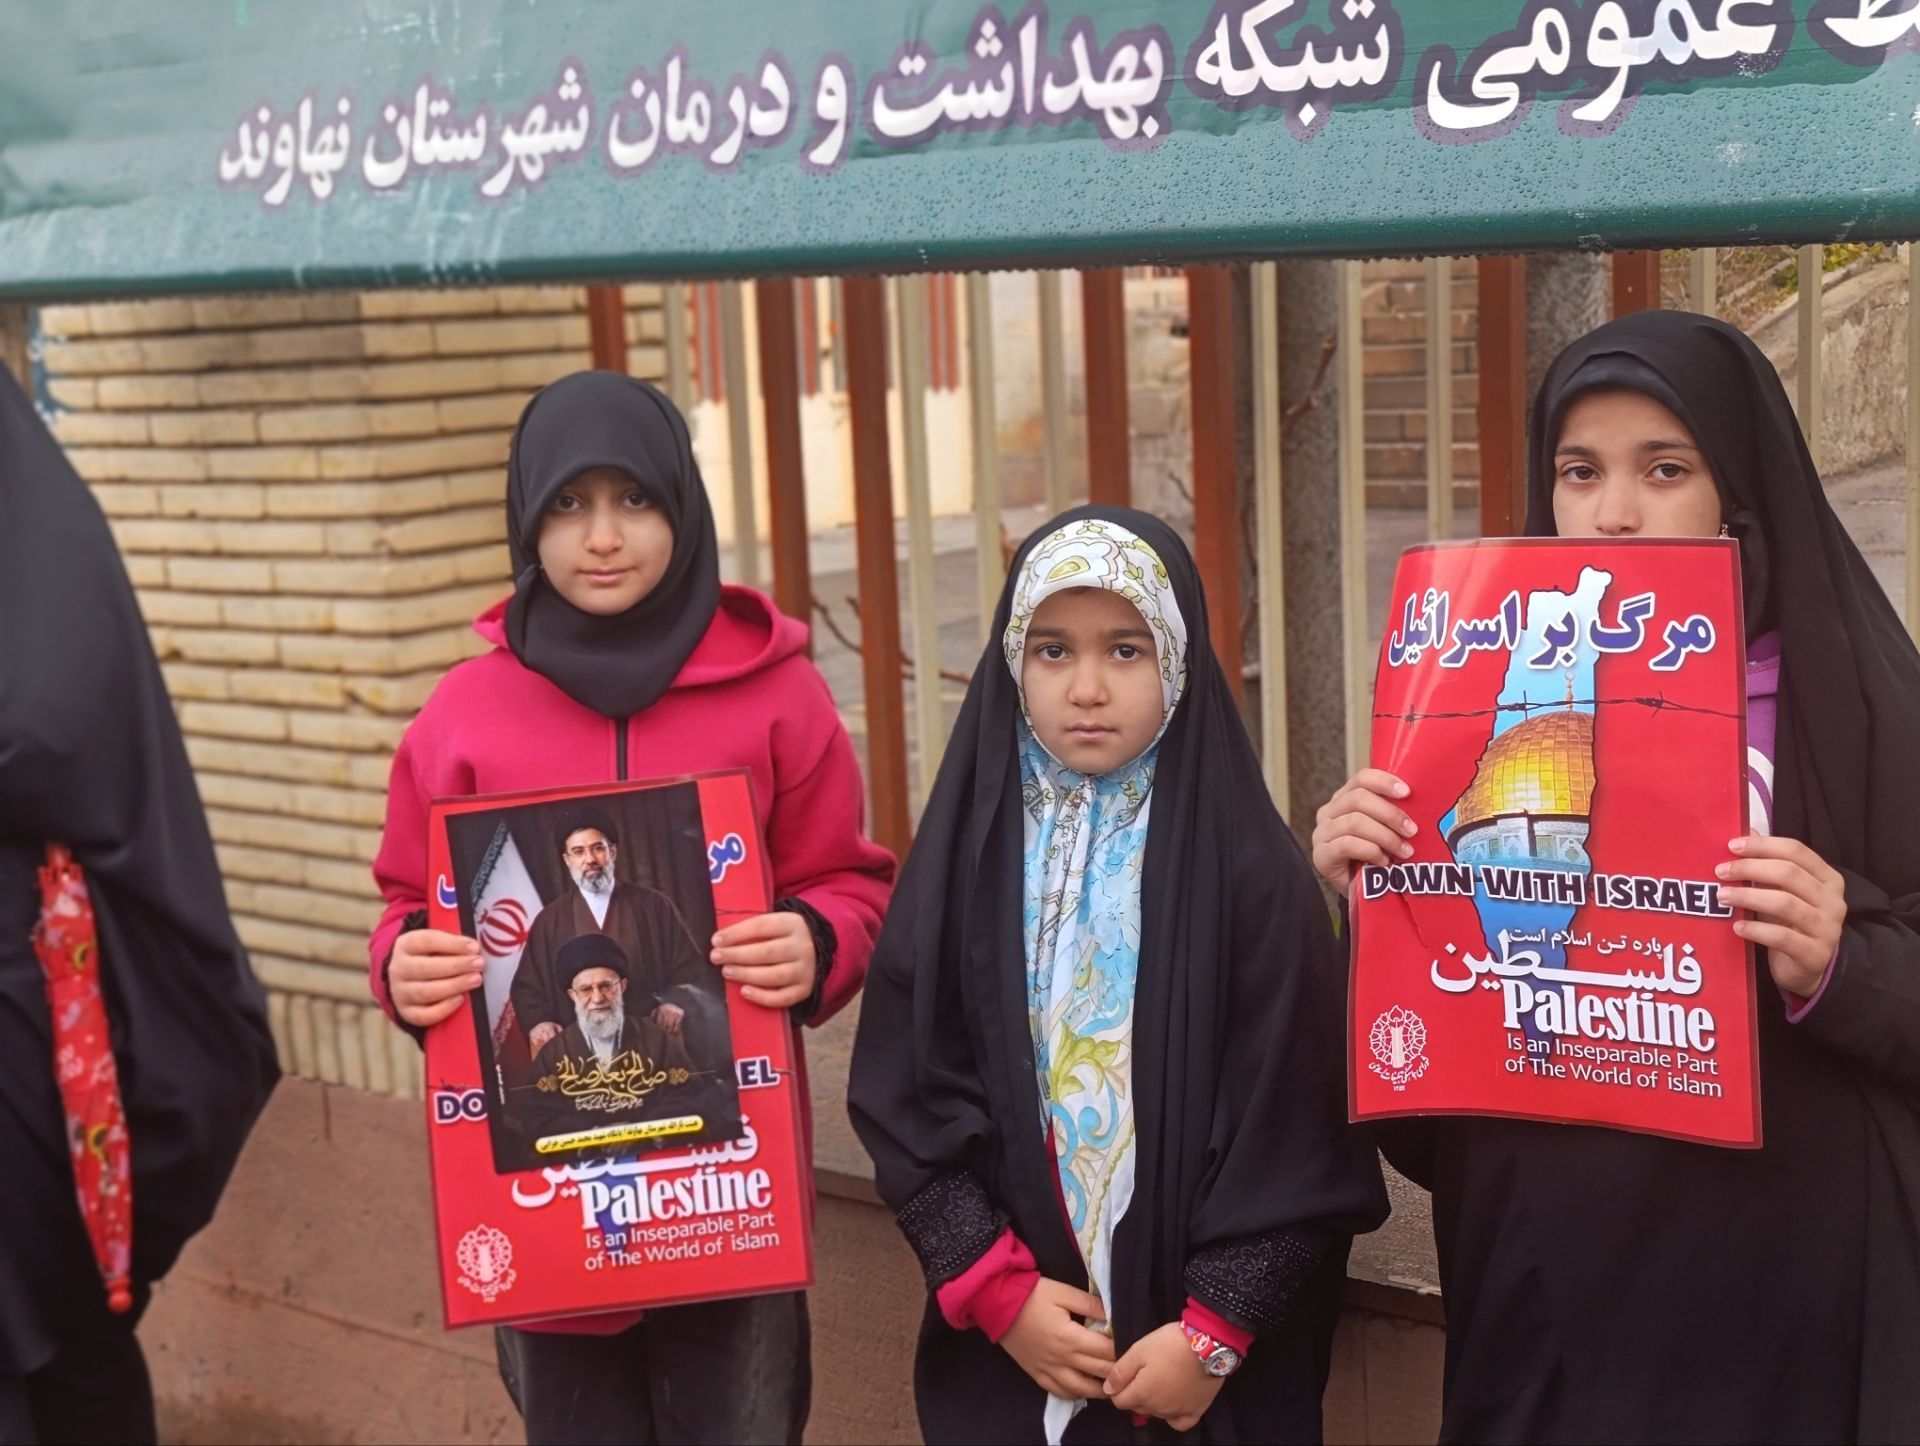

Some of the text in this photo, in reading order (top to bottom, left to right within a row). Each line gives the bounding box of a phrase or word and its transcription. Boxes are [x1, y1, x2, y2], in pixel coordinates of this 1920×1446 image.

[220, 0, 1777, 204] عمومی شبکه بهداشت و درمان شهرستان نهاوند
[1388, 587, 1715, 670] مرگ بر اسرائیل
[1362, 863, 1733, 917] DOWN WITH ISRAEL
[1430, 930, 1703, 995] فلسطین
[1508, 928, 1663, 959] پاره تن اسلام است
[1501, 978, 1715, 1053] Palestine
[1505, 1056, 1721, 1098] of The World of islam
[1507, 1033, 1719, 1075] Is an Inseparable Part
[433, 1088, 488, 1124] DO
[579, 1167, 772, 1230] Palestine
[584, 1232, 780, 1271] of The World of islam
[586, 1213, 775, 1249] Is an Inseparable Part
